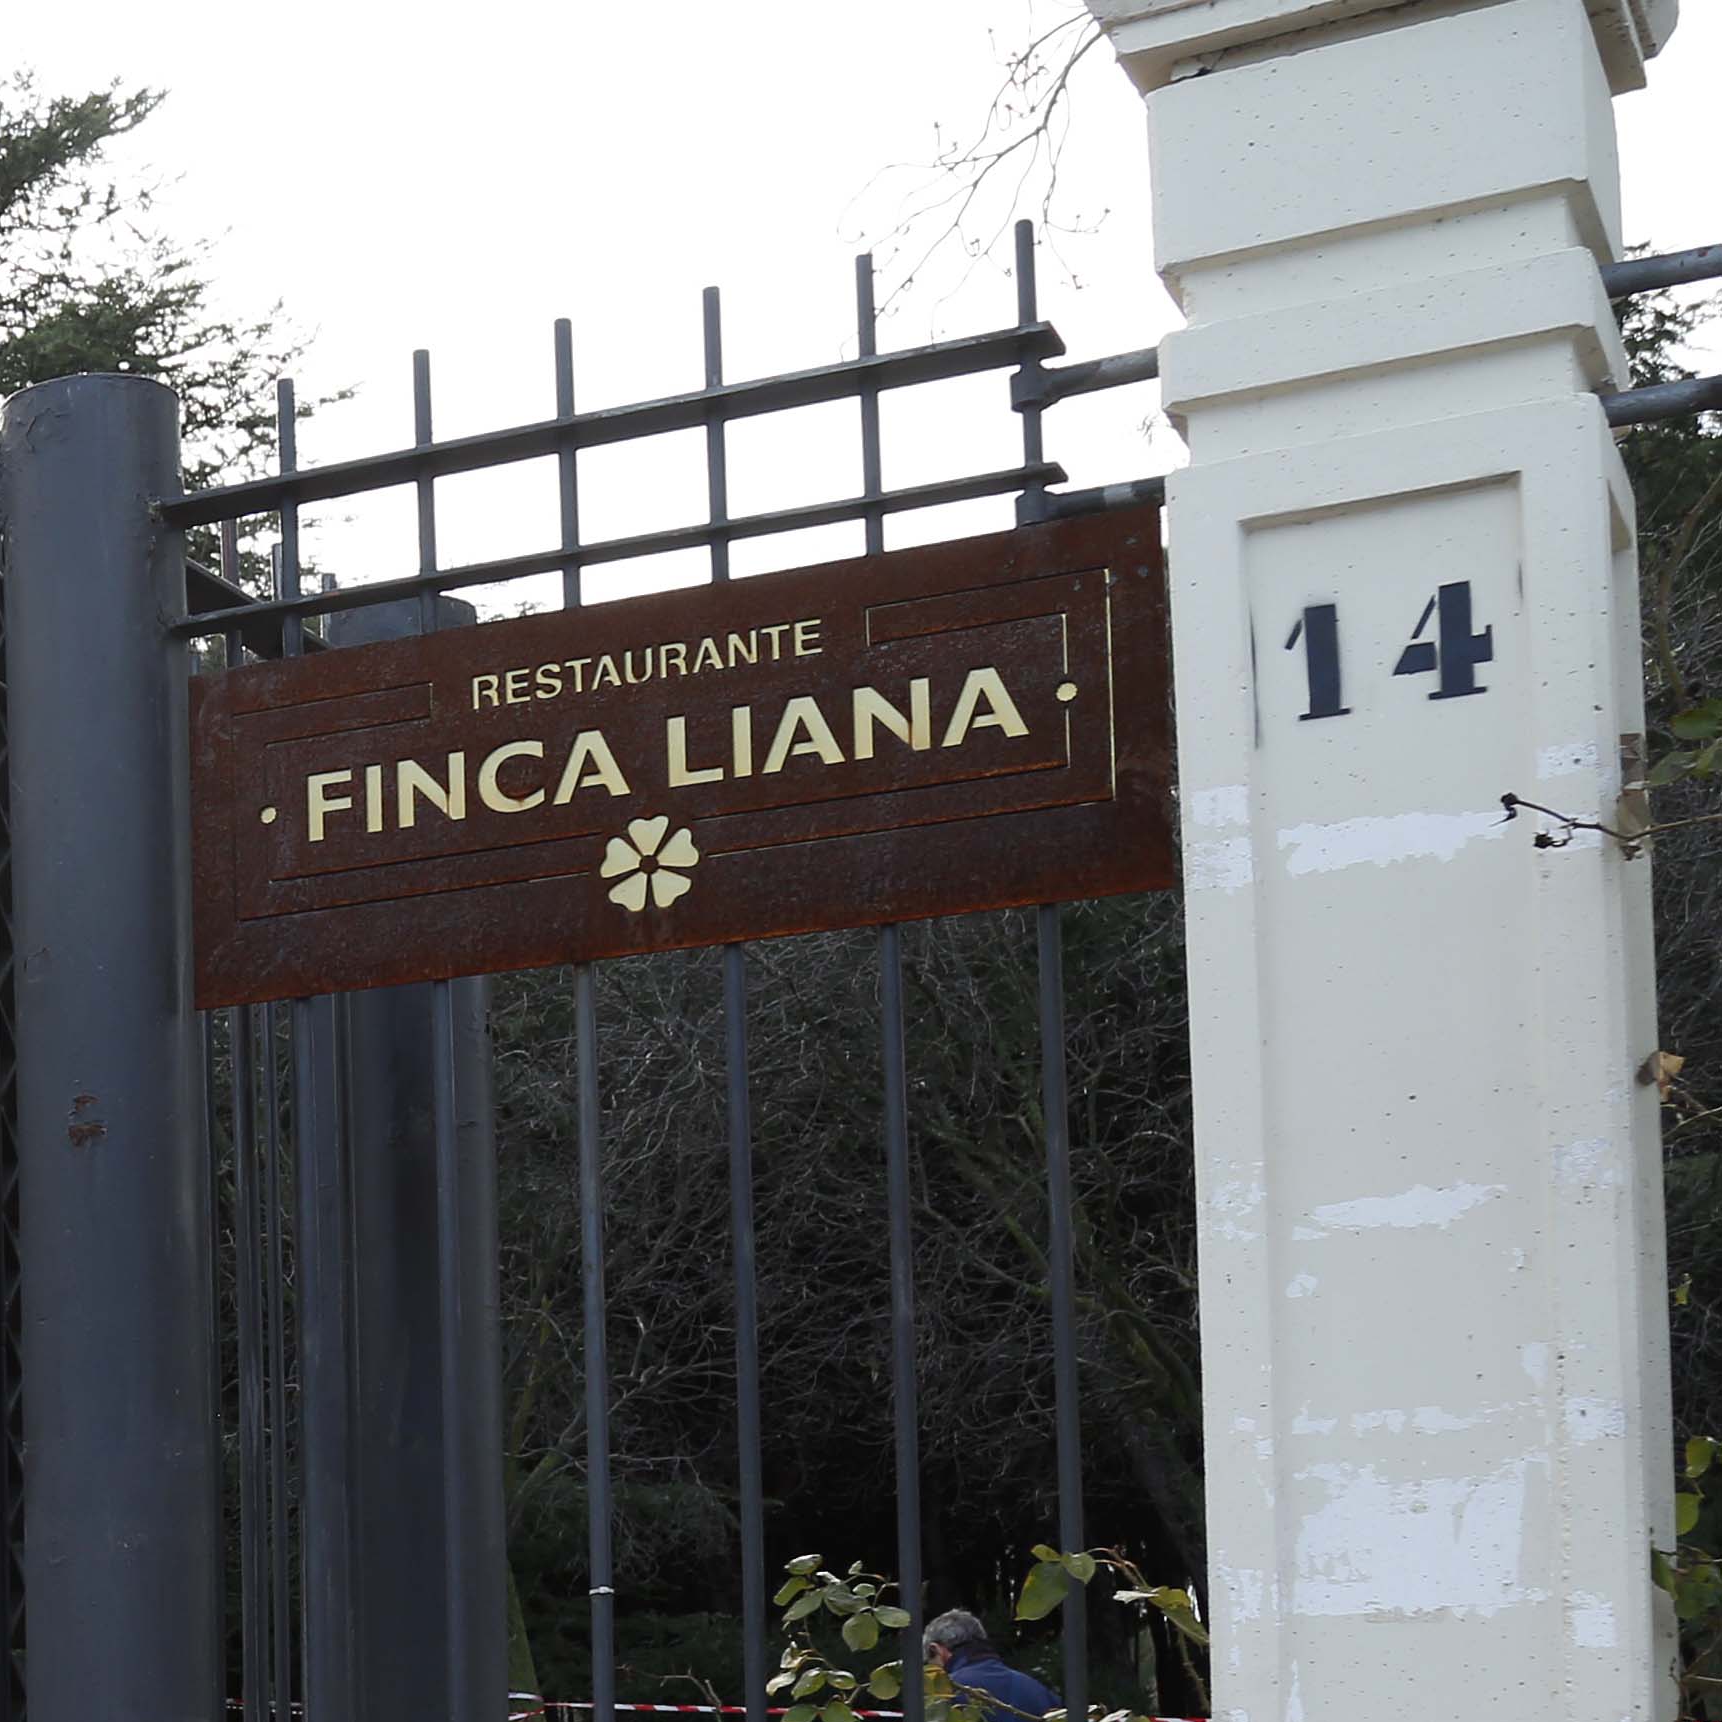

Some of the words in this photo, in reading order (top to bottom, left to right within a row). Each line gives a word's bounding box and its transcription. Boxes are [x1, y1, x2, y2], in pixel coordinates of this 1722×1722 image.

[472, 618, 826, 712] RESTAURANTE
[1284, 580, 1493, 720] 14
[308, 729, 631, 842] FINCA
[666, 666, 1031, 790] LIANA
